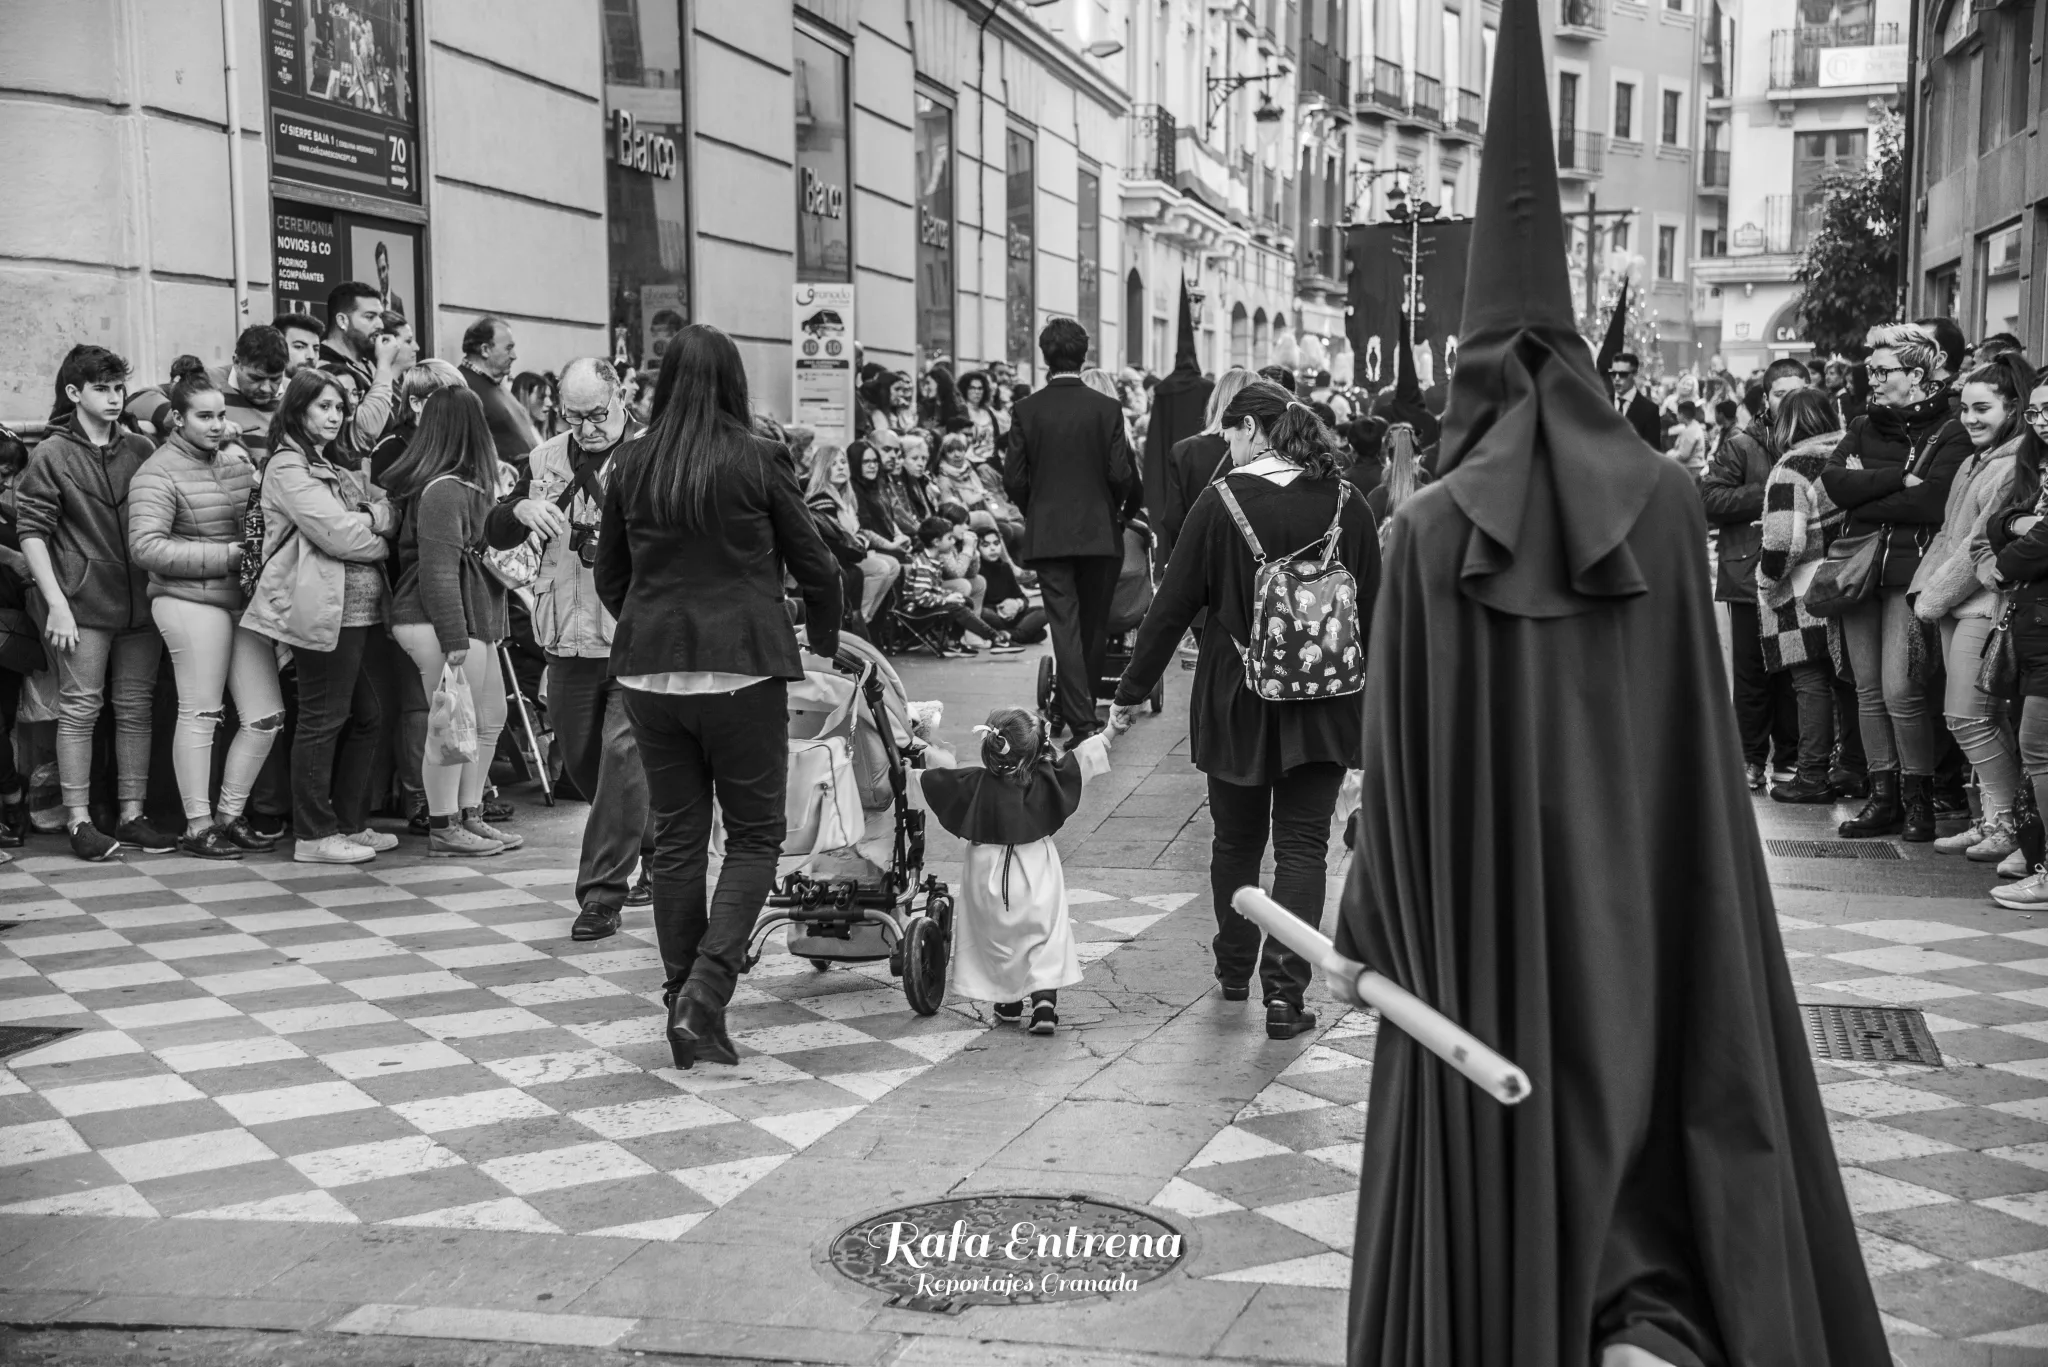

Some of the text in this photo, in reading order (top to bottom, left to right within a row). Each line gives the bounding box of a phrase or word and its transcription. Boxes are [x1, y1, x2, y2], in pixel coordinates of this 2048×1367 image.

[288, 125, 313, 141] SIERPE
[313, 131, 330, 144] BAJA
[389, 135, 406, 164] 70
[613, 109, 677, 180] Blanco
[277, 215, 334, 237] CEREMONIA
[277, 235, 331, 255] NOVIOS & CO
[278, 256, 308, 269] PADRINOS
[278, 269, 325, 283] ACOMPAÑANTES
[279, 280, 299, 291] FIESTA
